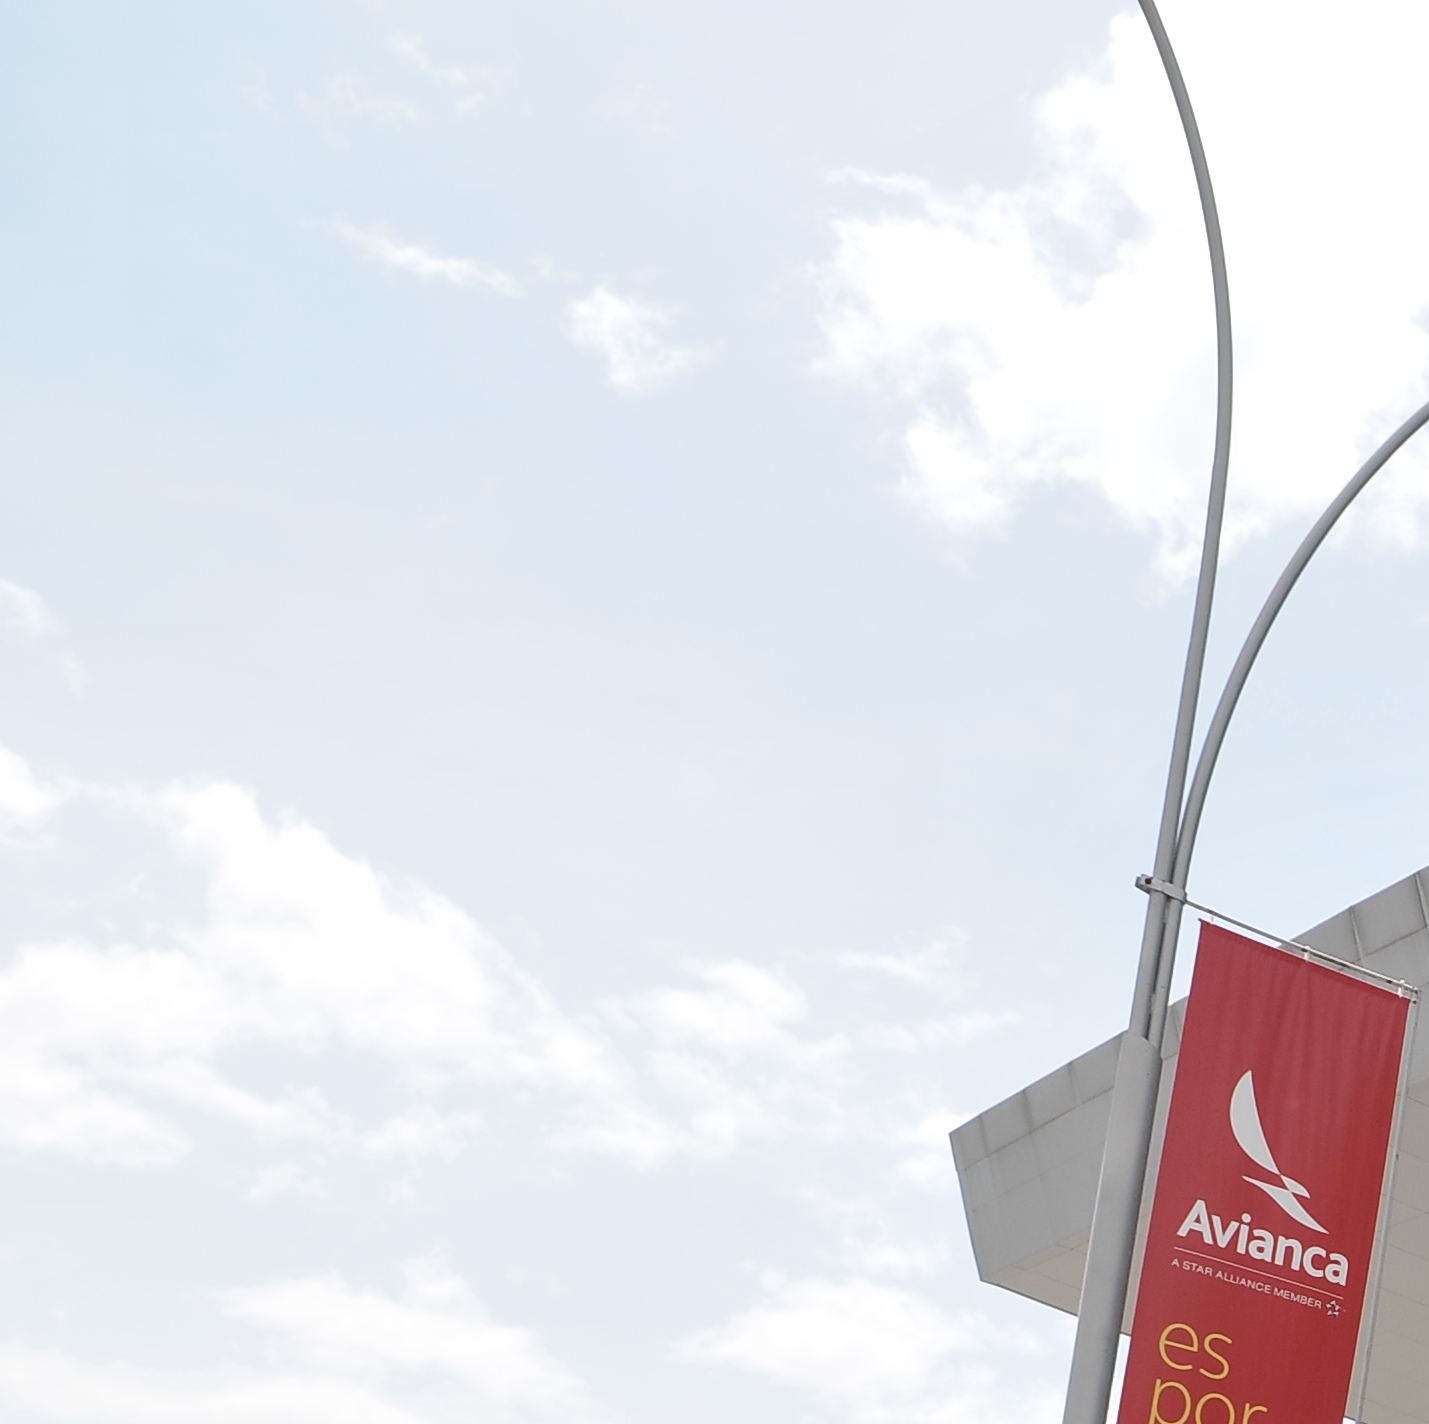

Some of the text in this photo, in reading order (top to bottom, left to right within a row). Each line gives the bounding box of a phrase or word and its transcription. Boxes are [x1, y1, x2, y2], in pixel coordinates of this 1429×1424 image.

[1176, 1199, 1349, 1287] Avianca
[1171, 1258, 1323, 1309] A STAR ALLIANCE MEMBER
[1158, 1322, 1233, 1380] es
